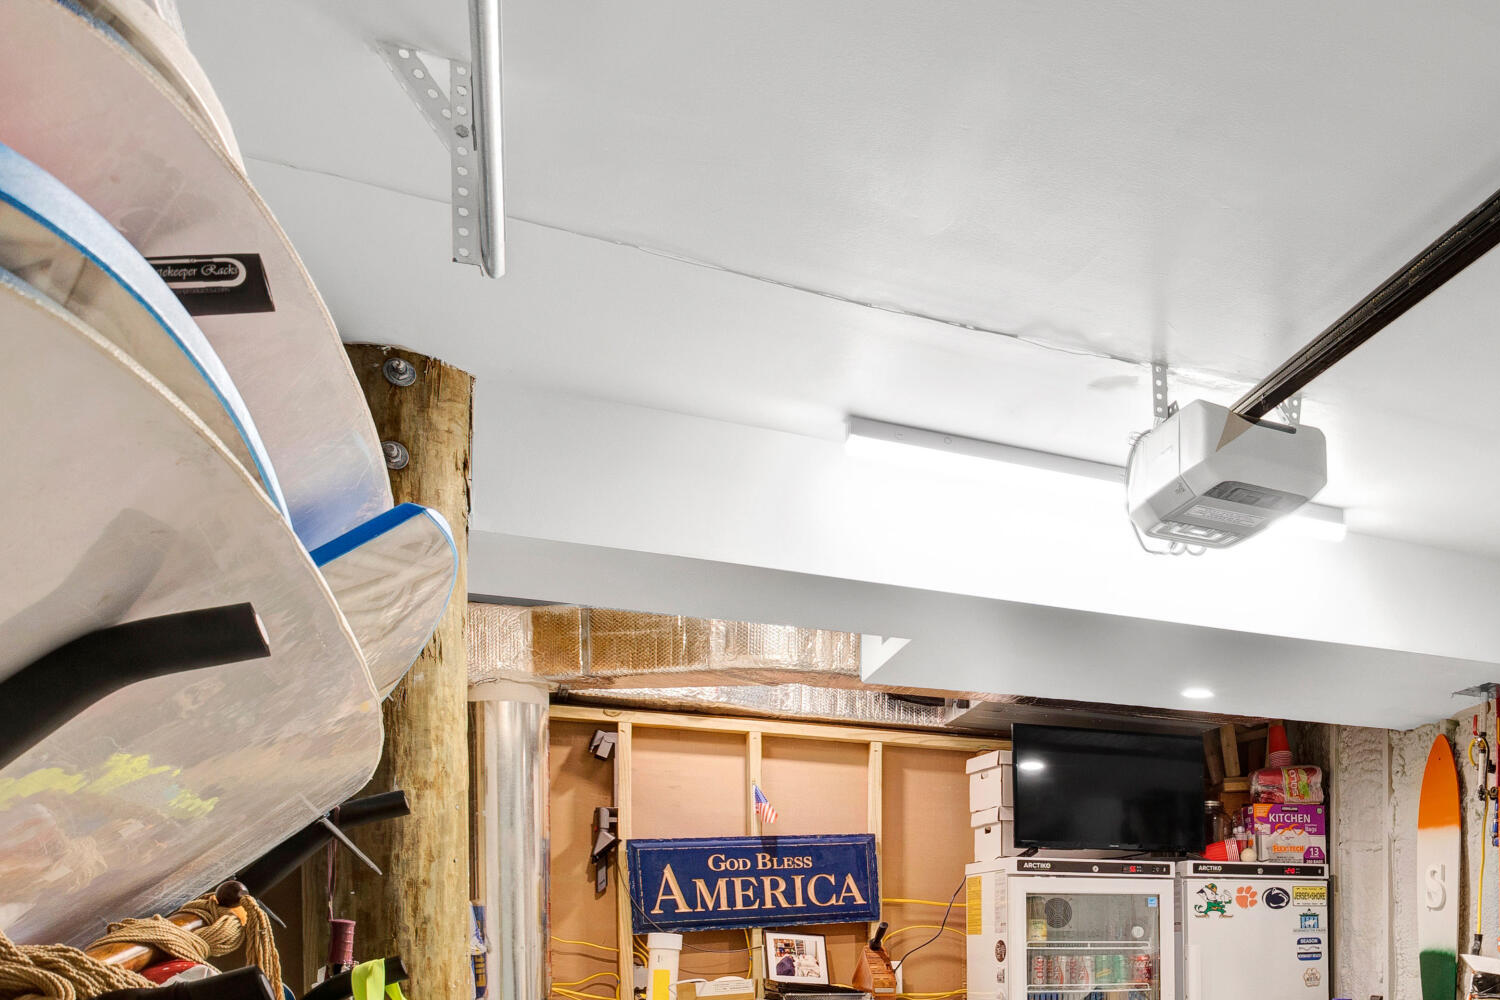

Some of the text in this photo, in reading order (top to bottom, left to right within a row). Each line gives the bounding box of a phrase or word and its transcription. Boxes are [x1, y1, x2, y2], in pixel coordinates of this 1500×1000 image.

[201, 264, 238, 276] Racks
[1269, 813, 1311, 823] KITCHEN
[1309, 847, 1319, 856] 13
[707, 853, 813, 871] GOD BLESS
[650, 863, 867, 914] AMERICA
[1425, 863, 1447, 912] S
